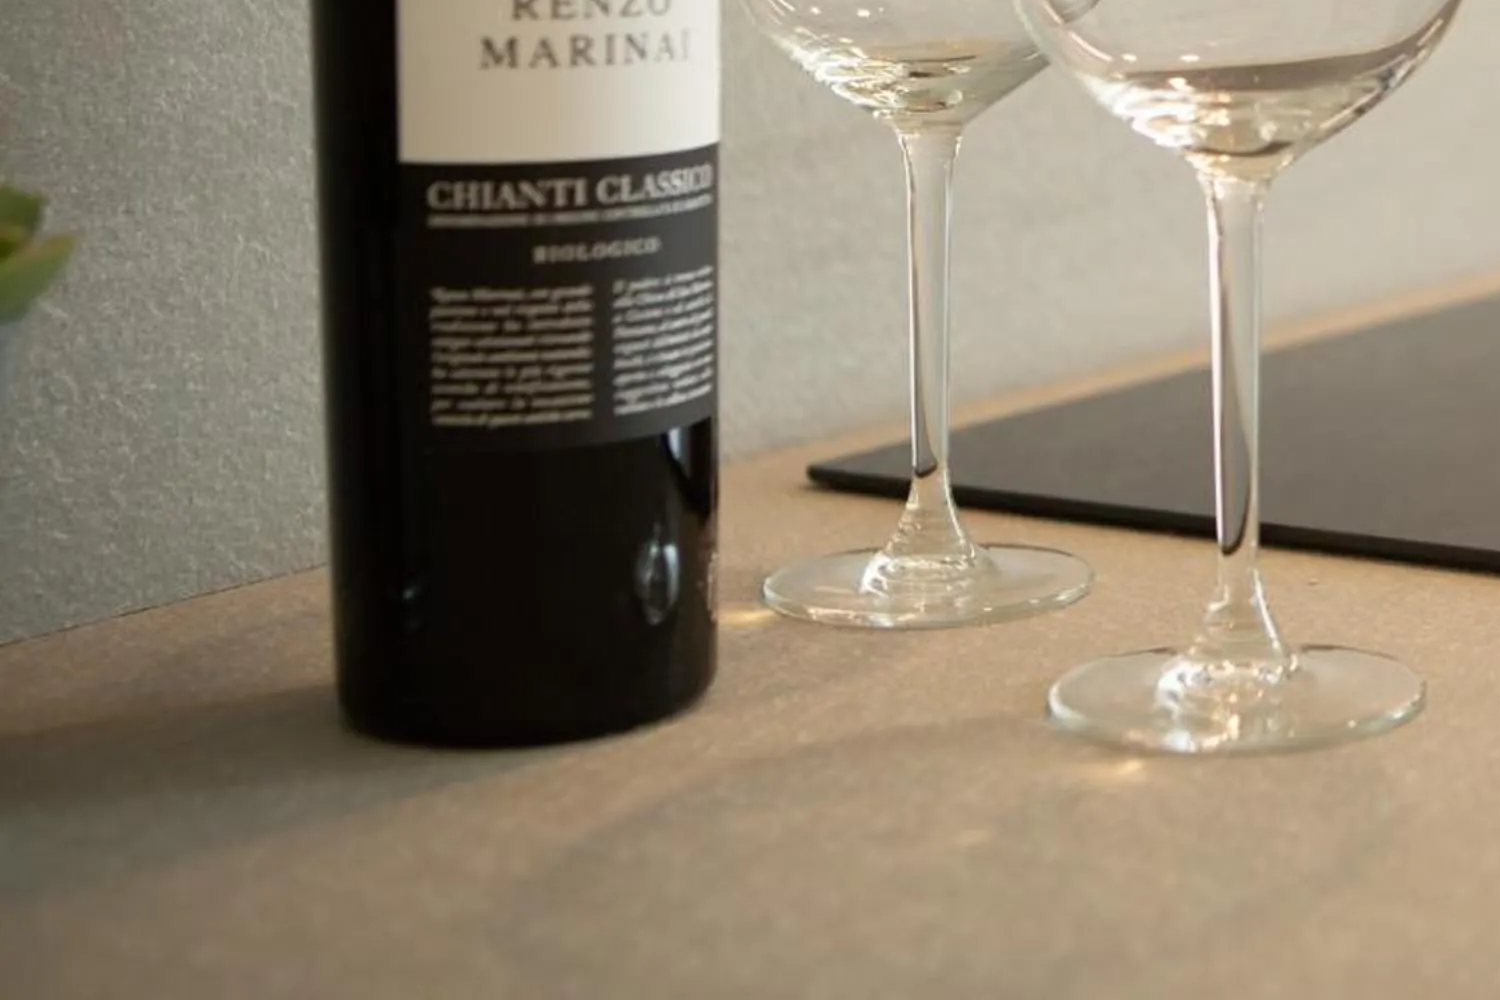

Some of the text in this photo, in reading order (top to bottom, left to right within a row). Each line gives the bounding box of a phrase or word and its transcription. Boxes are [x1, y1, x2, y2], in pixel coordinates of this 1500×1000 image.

[477, 27, 692, 70] MARINAI
[425, 161, 714, 211] CHIANTI CLASSICO
